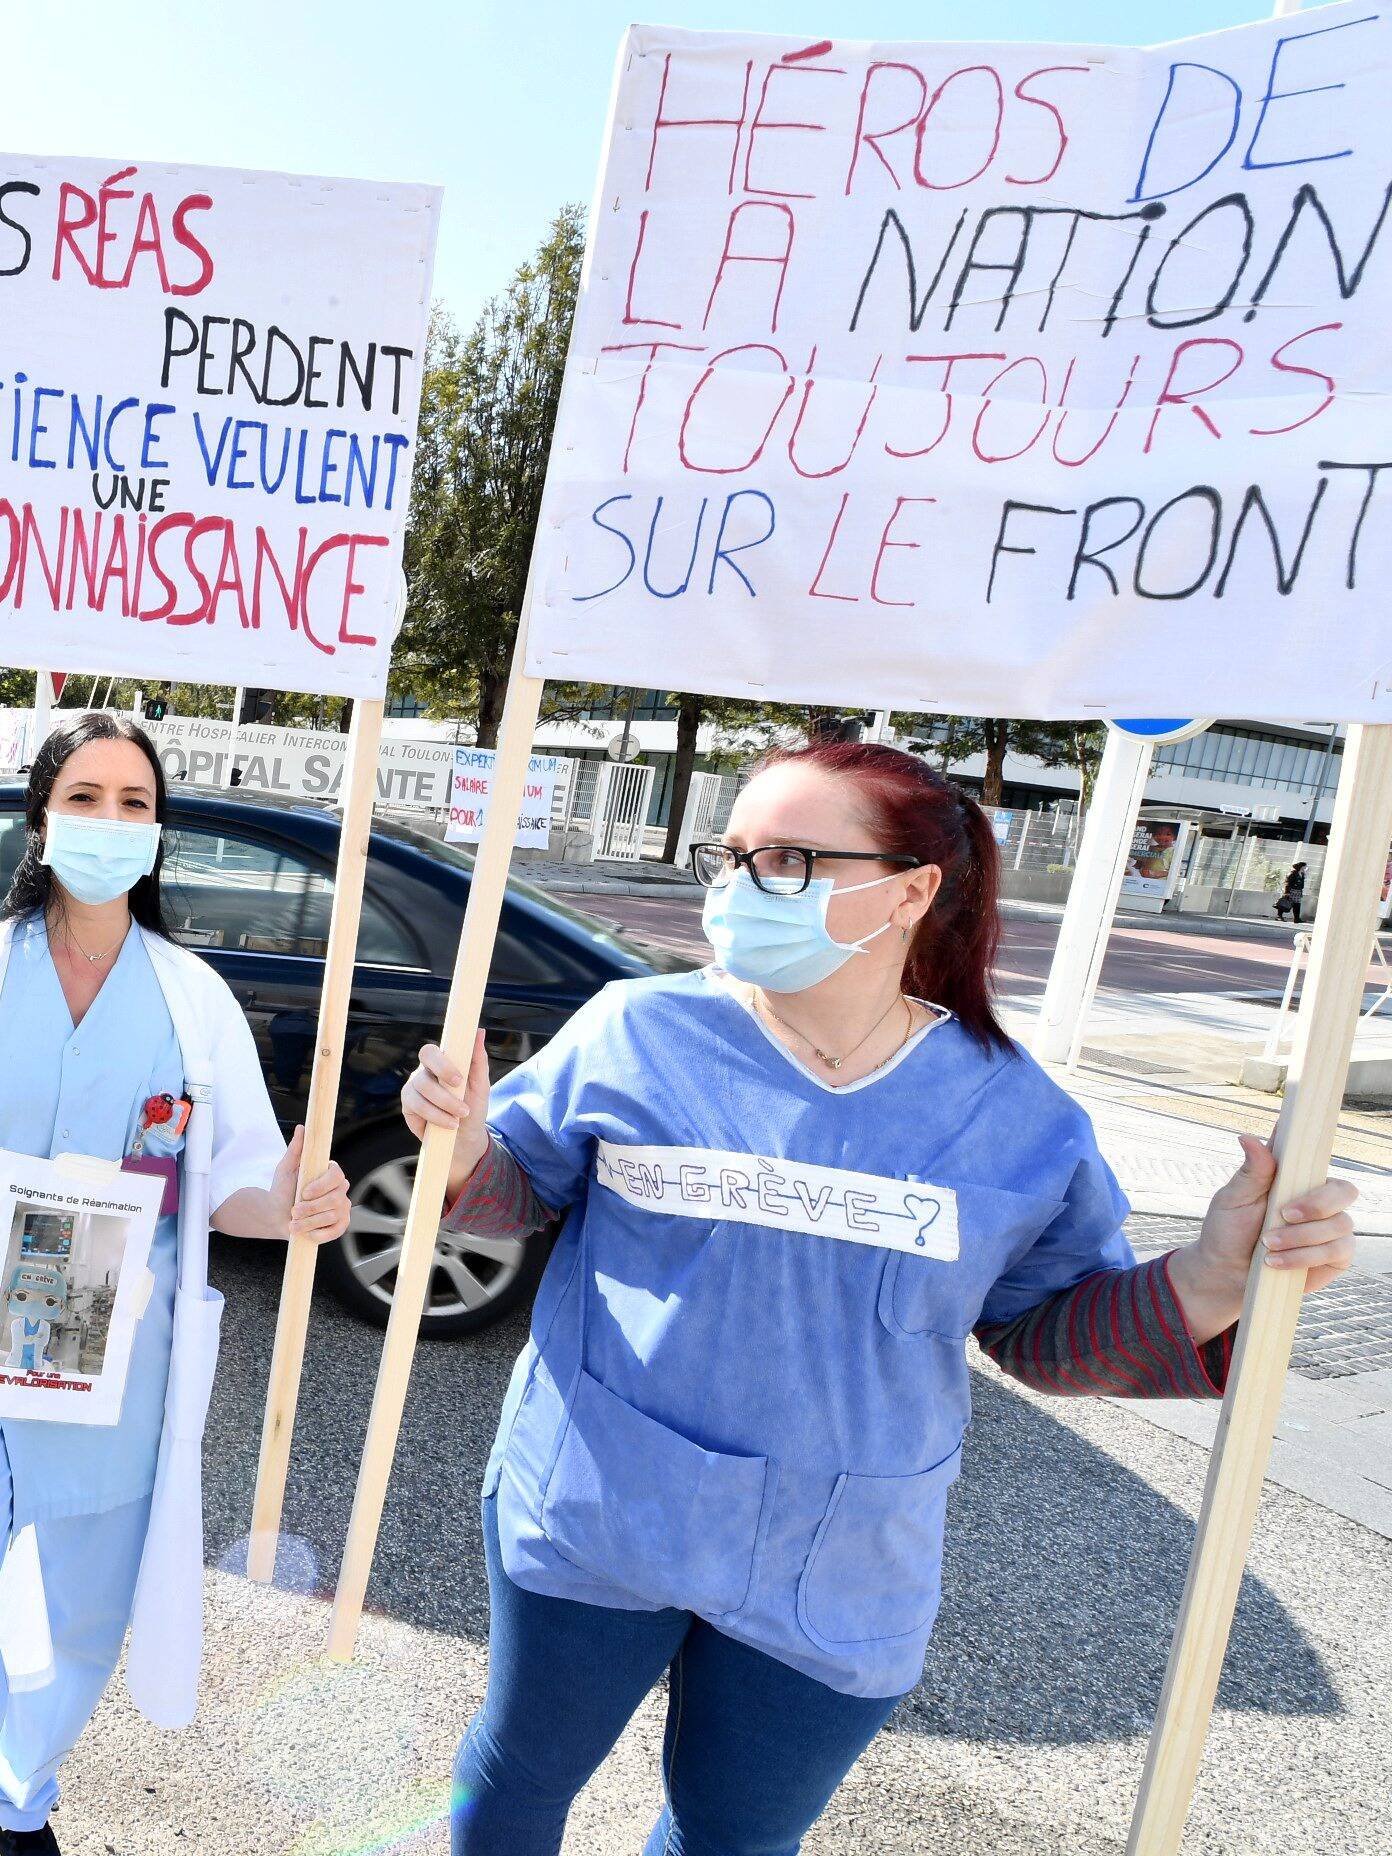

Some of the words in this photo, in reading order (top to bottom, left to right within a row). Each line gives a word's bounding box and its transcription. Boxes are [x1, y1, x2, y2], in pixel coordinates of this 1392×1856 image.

[644, 40, 1091, 199] HÉROS
[1127, 14, 1381, 204] DE
[51, 166, 214, 296] RÉAS
[622, 201, 798, 334] LA
[160, 306, 413, 415] PERDENT
[600, 322, 1345, 479] TOUJOURS
[92, 473, 171, 513] UNE
[194, 411, 409, 511] VEULENT
[571, 489, 777, 602] SUR
[808, 493, 938, 607] LE
[986, 460, 1392, 604] FRONT
[141, 721, 185, 736] ENTRE
[9, 1184, 64, 1202] Soignants
[66, 1195, 80, 1205] de
[81, 1197, 143, 1213] Réanimation
[618, 1158, 665, 1200] EN
[679, 1157, 880, 1232] GRÈVE
